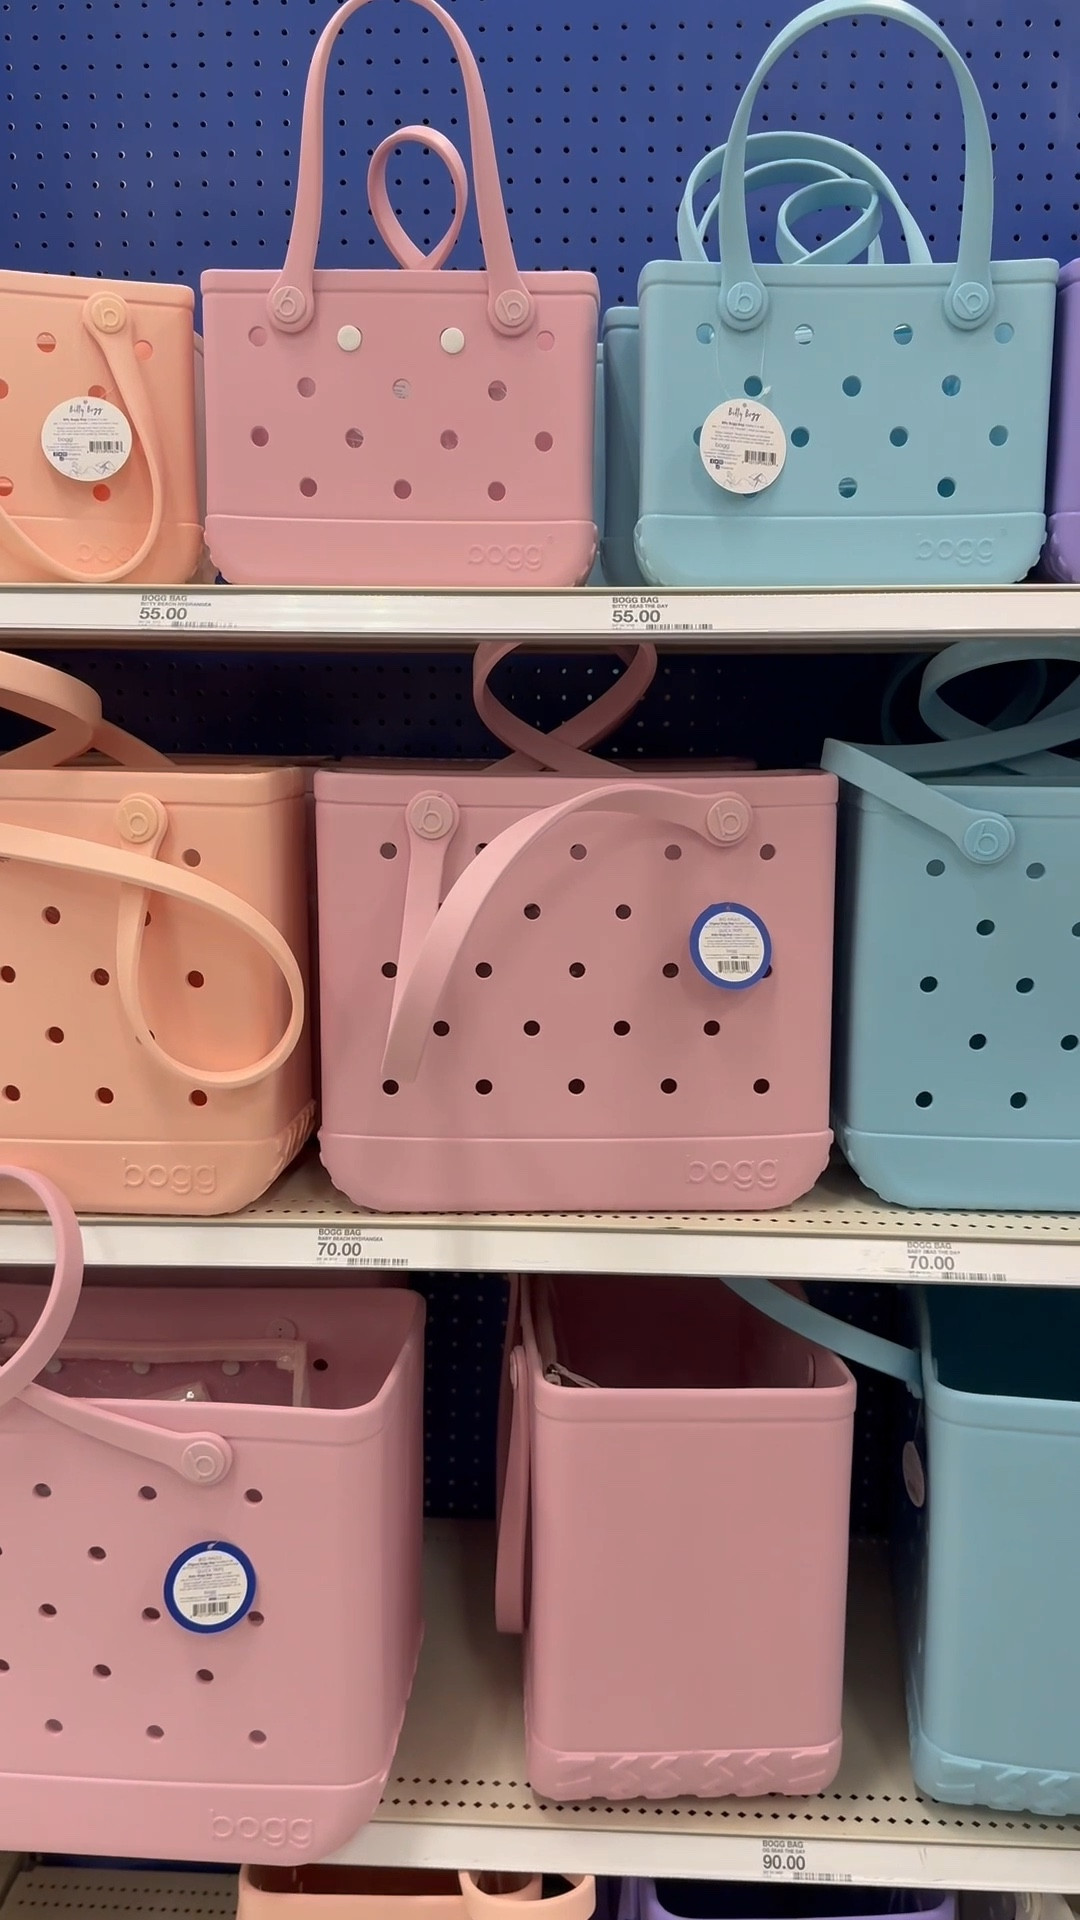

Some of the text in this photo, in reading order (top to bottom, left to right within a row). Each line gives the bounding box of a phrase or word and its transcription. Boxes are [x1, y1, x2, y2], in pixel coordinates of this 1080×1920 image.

[466, 533, 544, 571] bogg
[914, 531, 995, 567] bogg
[141, 594, 167, 602] BOGG
[612, 596, 659, 604] BOGG BAG
[139, 606, 188, 620] 55.00
[612, 609, 661, 623] 55.00
[121, 1156, 218, 1196] bogg
[684, 1152, 779, 1192] bogg
[318, 1228, 343, 1236] BOGG
[317, 1242, 362, 1257] 70.00
[907, 1241, 952, 1250] BOGG BAG
[907, 1255, 955, 1271] 70.00
[208, 1806, 315, 1850] bogg
[762, 1839, 804, 1849] BOGG BAG
[762, 1854, 806, 1871] 90.00
